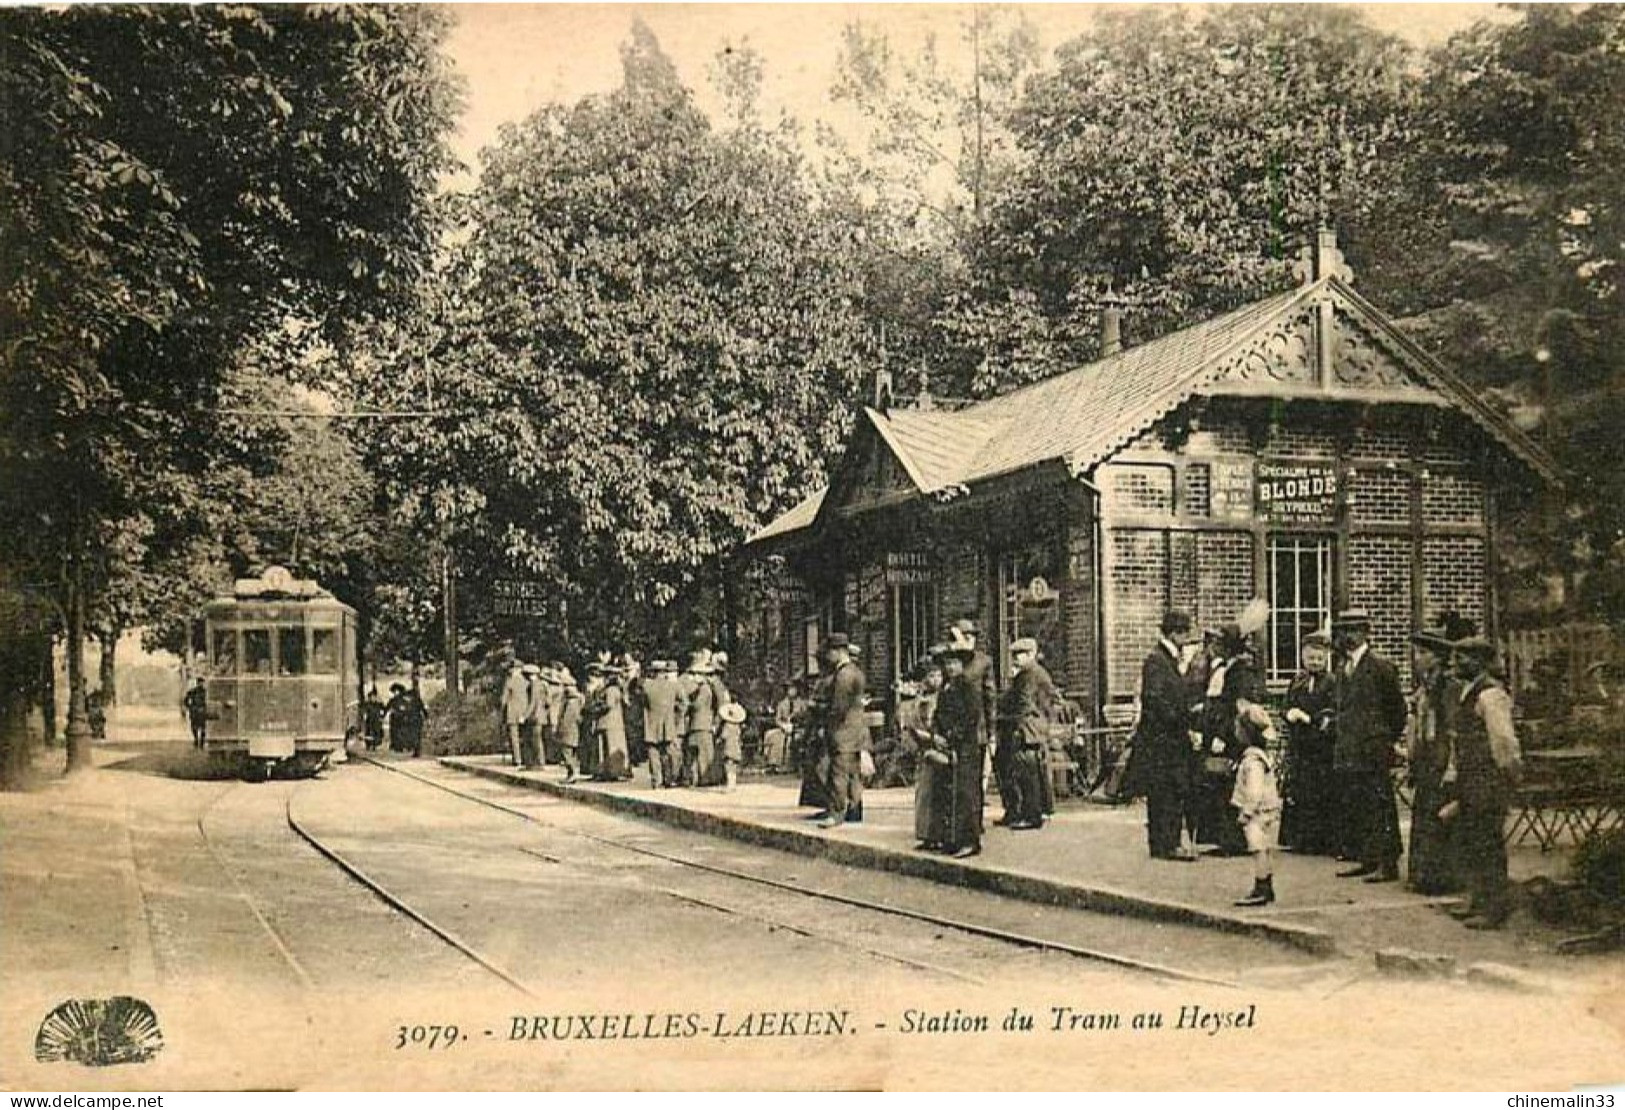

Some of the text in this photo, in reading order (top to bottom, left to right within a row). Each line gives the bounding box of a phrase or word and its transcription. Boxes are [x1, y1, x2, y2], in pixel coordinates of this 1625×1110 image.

[1260, 476, 1336, 501] BLONDE
[396, 1024, 468, 1049] 3079.
[509, 1011, 858, 1041] BRUXELLES-LAEKEN.
[899, 1008, 988, 1034] Station
[1002, 1007, 1034, 1031] du
[1050, 1006, 1120, 1031] Tram
[1131, 1013, 1163, 1030] au
[1176, 1003, 1257, 1036] Heysel
